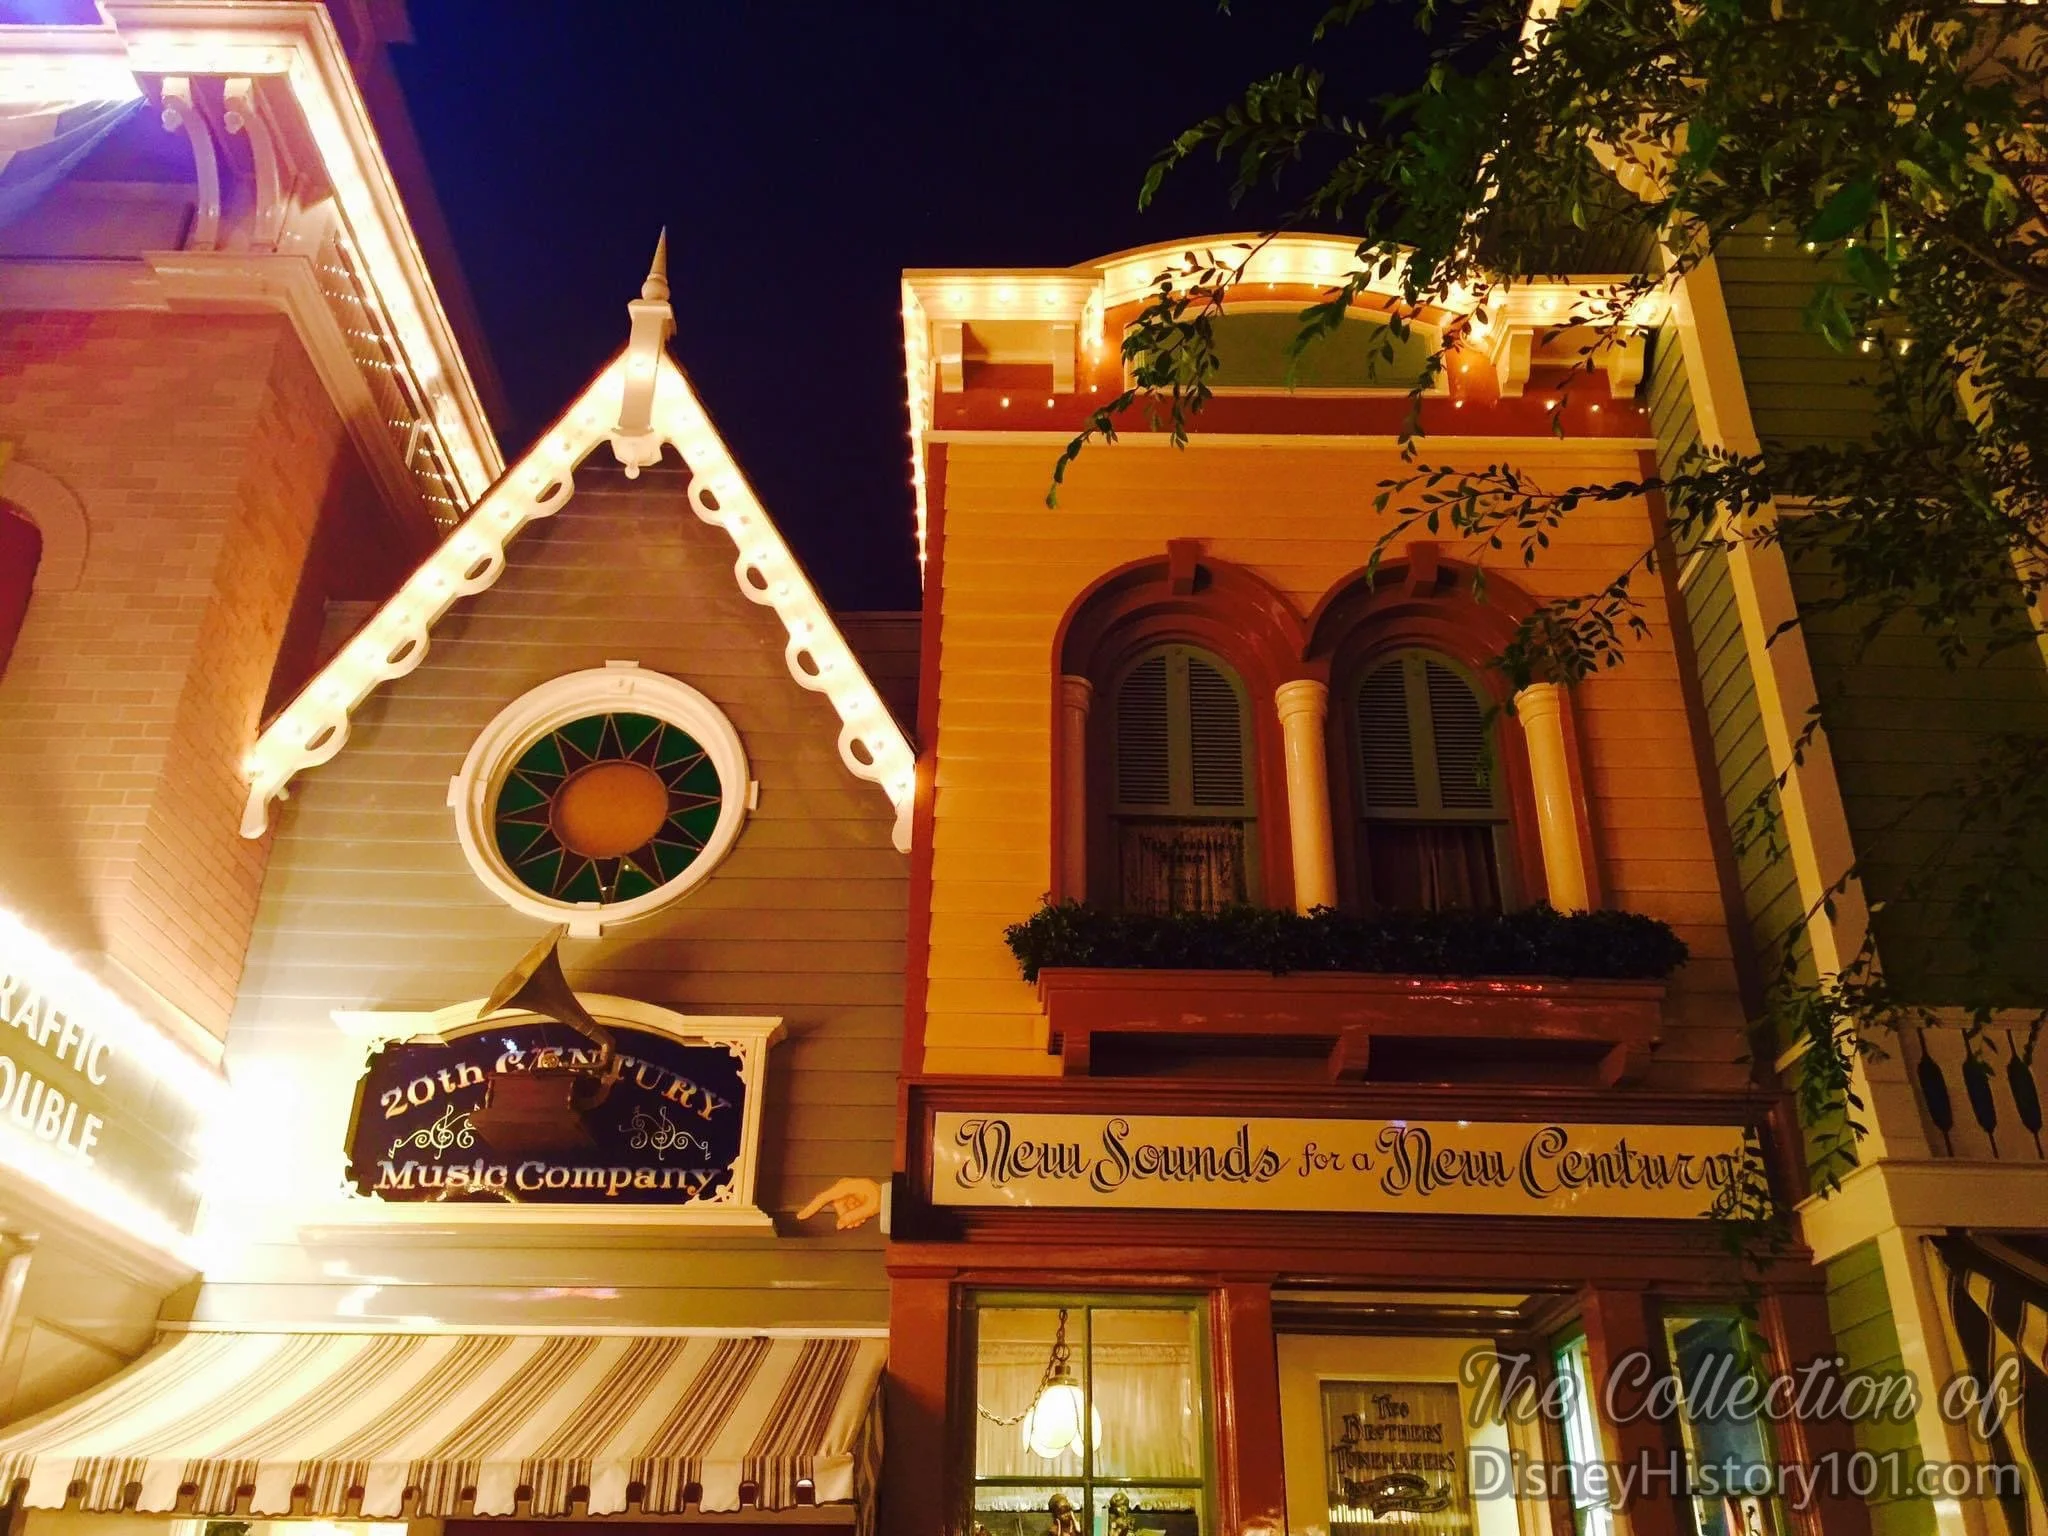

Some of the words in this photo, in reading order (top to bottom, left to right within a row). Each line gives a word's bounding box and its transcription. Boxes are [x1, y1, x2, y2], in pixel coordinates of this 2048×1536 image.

[380, 1062, 487, 1121] 20th
[373, 1158, 509, 1191] Music
[515, 1160, 721, 1196] Company
[955, 1118, 1091, 1189] New
[1090, 1117, 1291, 1193] Sounds
[1299, 1142, 1344, 1177] for
[1352, 1153, 1375, 1172] a
[1375, 1126, 1515, 1197] New
[1519, 1126, 1740, 1210] Century
